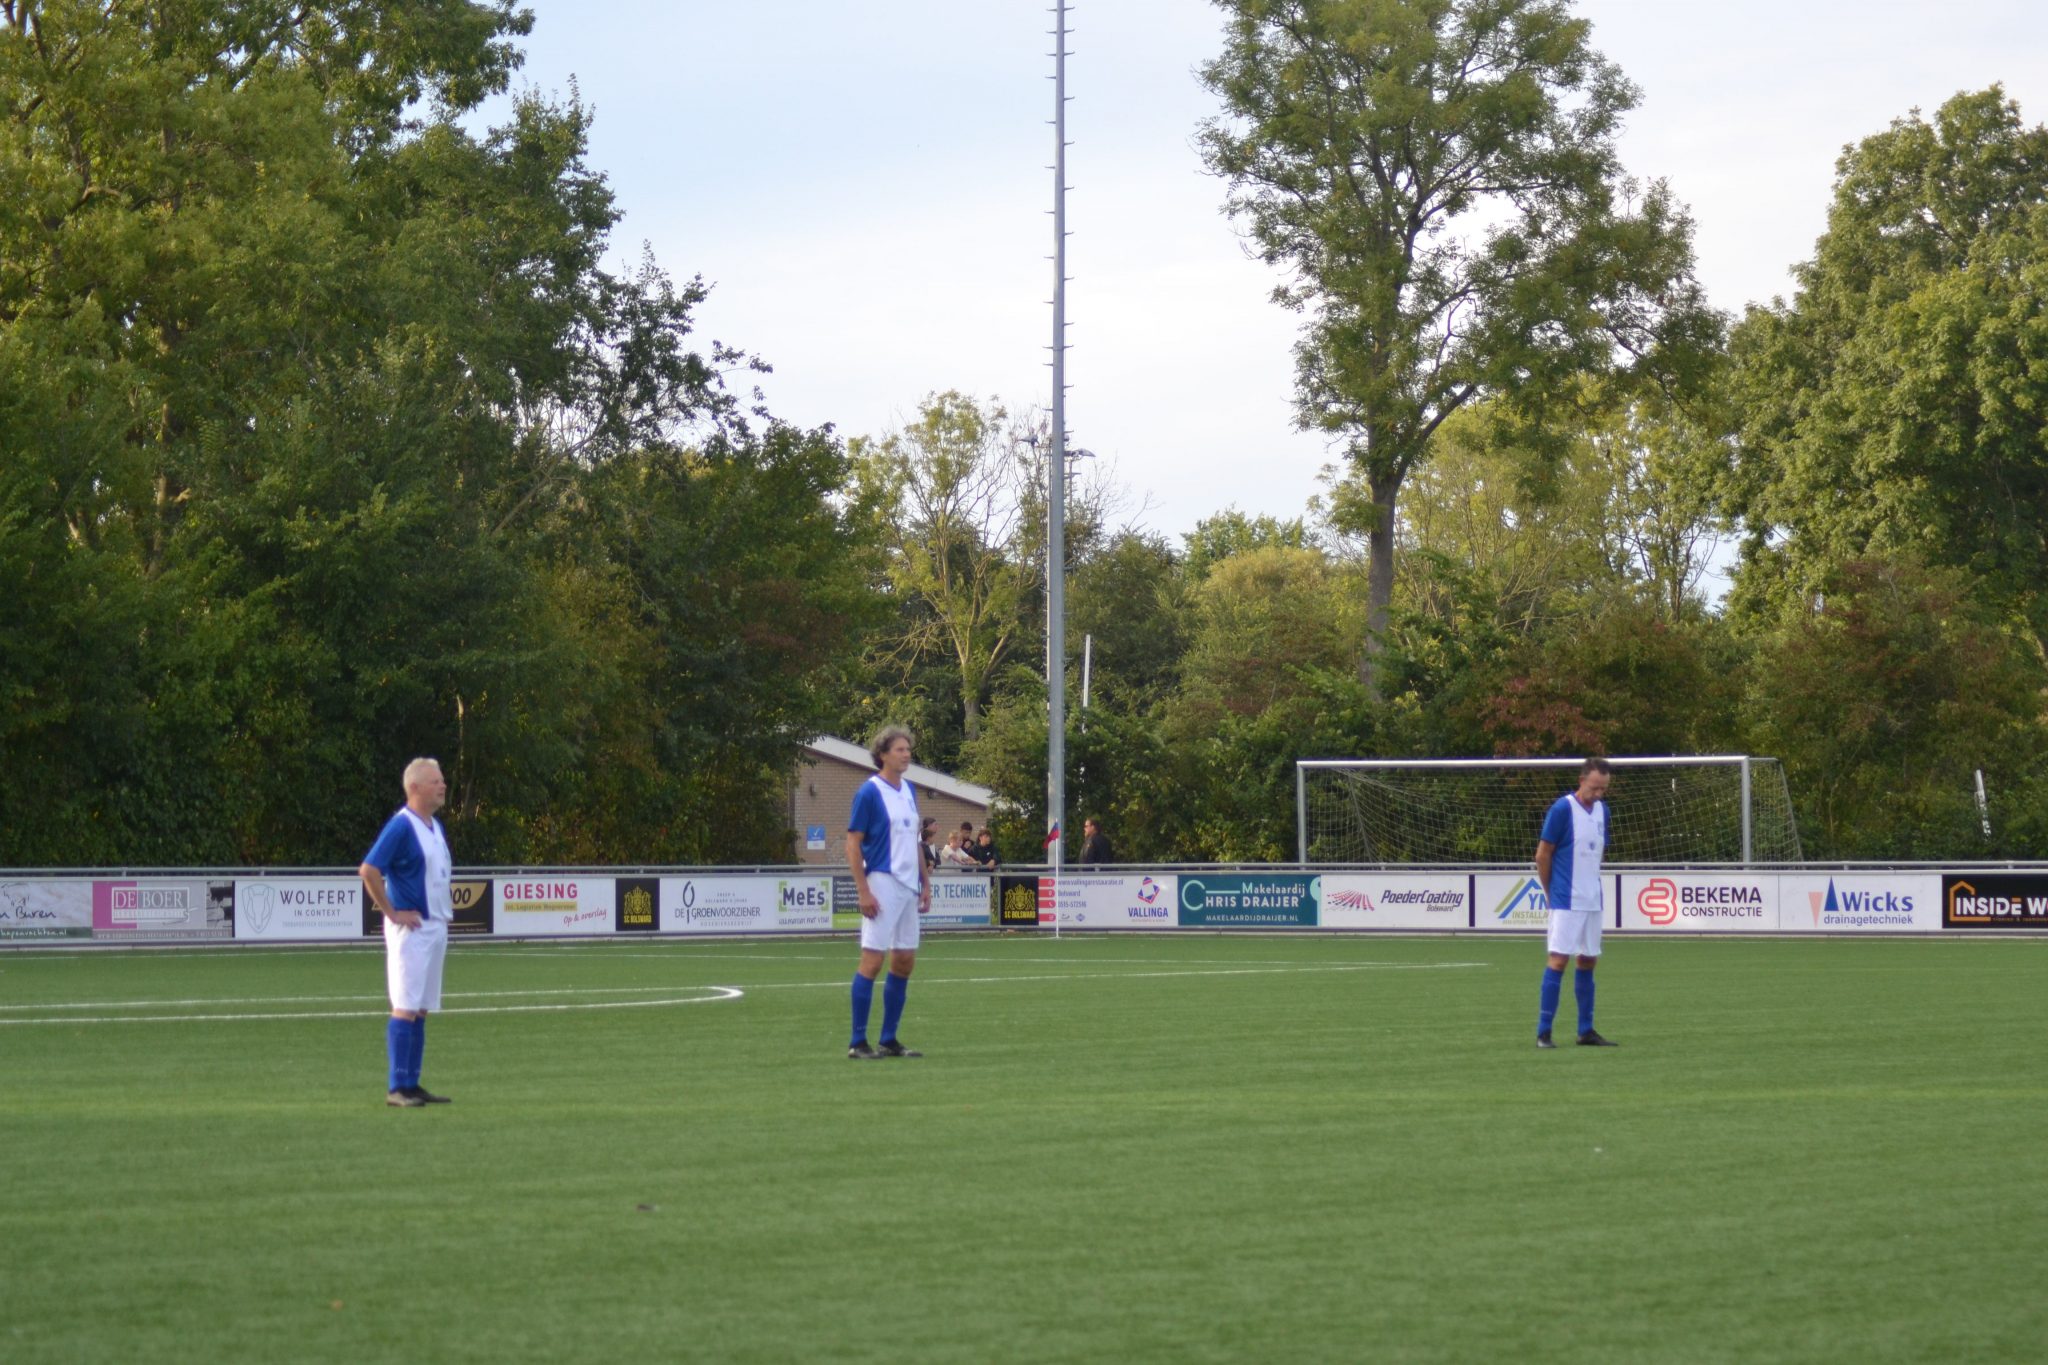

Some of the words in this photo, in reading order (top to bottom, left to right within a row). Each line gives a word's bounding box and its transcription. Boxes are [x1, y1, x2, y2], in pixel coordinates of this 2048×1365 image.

[280, 890, 356, 905] WOLFERT
[450, 888, 471, 905] 00
[504, 883, 578, 899] GIESING
[783, 887, 825, 905] MeEs
[944, 884, 987, 898] TECHNIEK
[1242, 882, 1305, 898] Makelaardij
[1681, 887, 1762, 903] BEKEMA
[115, 890, 136, 908] DE
[143, 890, 182, 908] BOER
[1242, 897, 1299, 907] DRAIJER
[1380, 890, 1464, 907] PoederCoating
[1842, 891, 1914, 912] Wicks
[1956, 897, 2022, 915] INSIDE
[2027, 897, 2048, 915] W
[16, 905, 56, 919] Buren
[294, 909, 302, 917] IN
[306, 909, 341, 917] CONTEXT
[675, 908, 685, 918] DE
[691, 907, 761, 919] GROENVOORZIENER
[1128, 907, 1168, 918] VALLINGA
[1427, 904, 1455, 912] Bolsward
[1682, 907, 1763, 917] CONSTRUCTIE
[564, 915, 573, 927] Op
[581, 906, 607, 920] overslag
[1824, 914, 1913, 926] drainagetechniek
